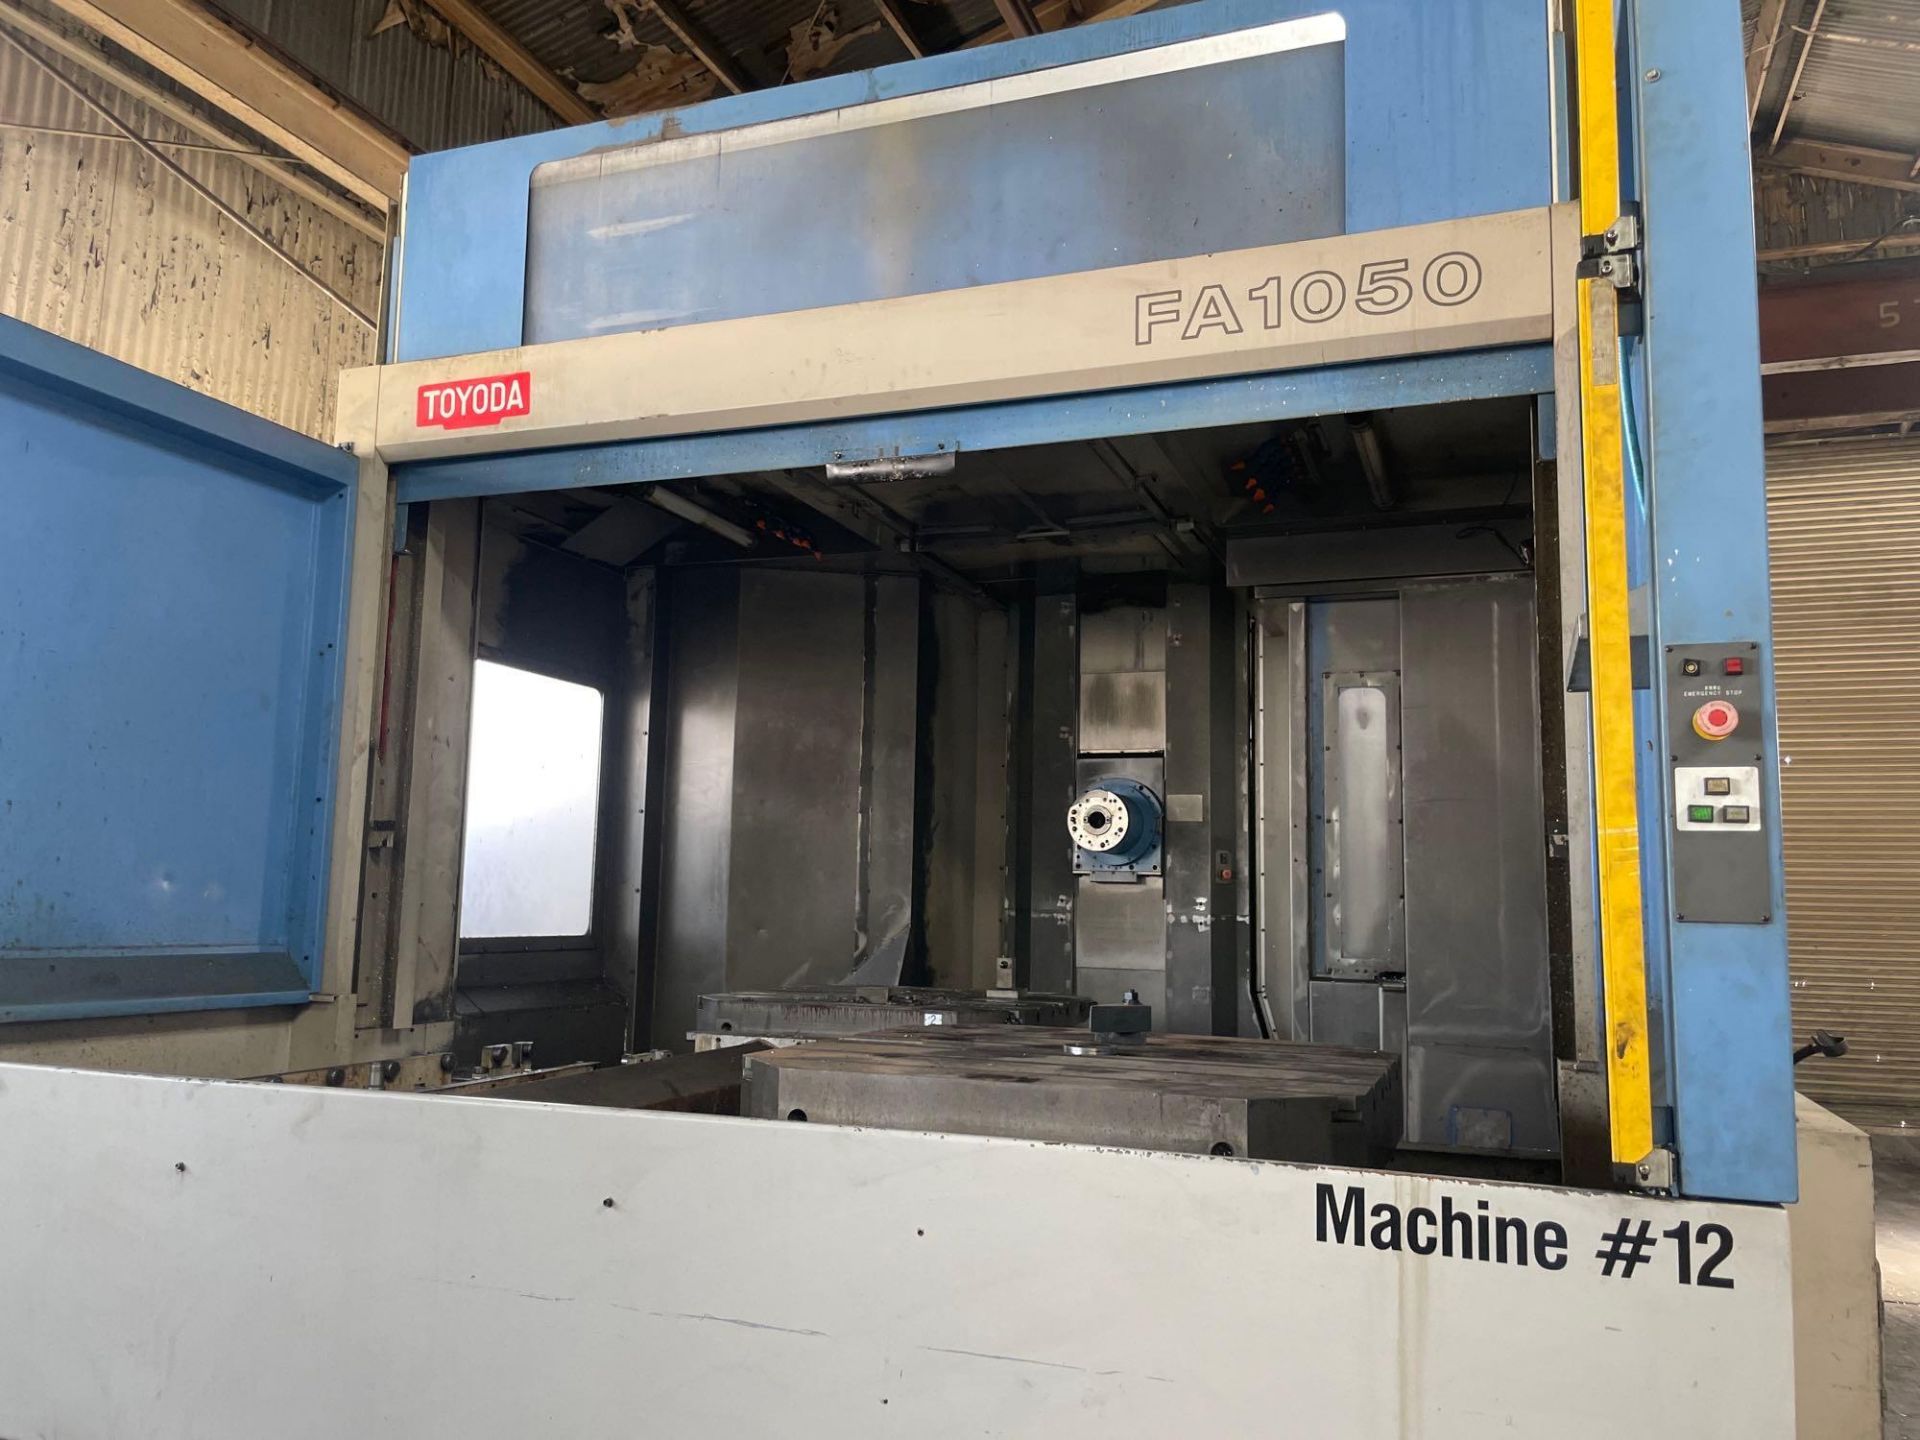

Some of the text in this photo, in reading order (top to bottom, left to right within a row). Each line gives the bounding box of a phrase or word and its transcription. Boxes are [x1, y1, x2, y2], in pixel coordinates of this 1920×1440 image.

[1135, 251, 1482, 346] FA1050
[423, 379, 524, 420] TOYODA
[1315, 1182, 1735, 1290] Machine #12
